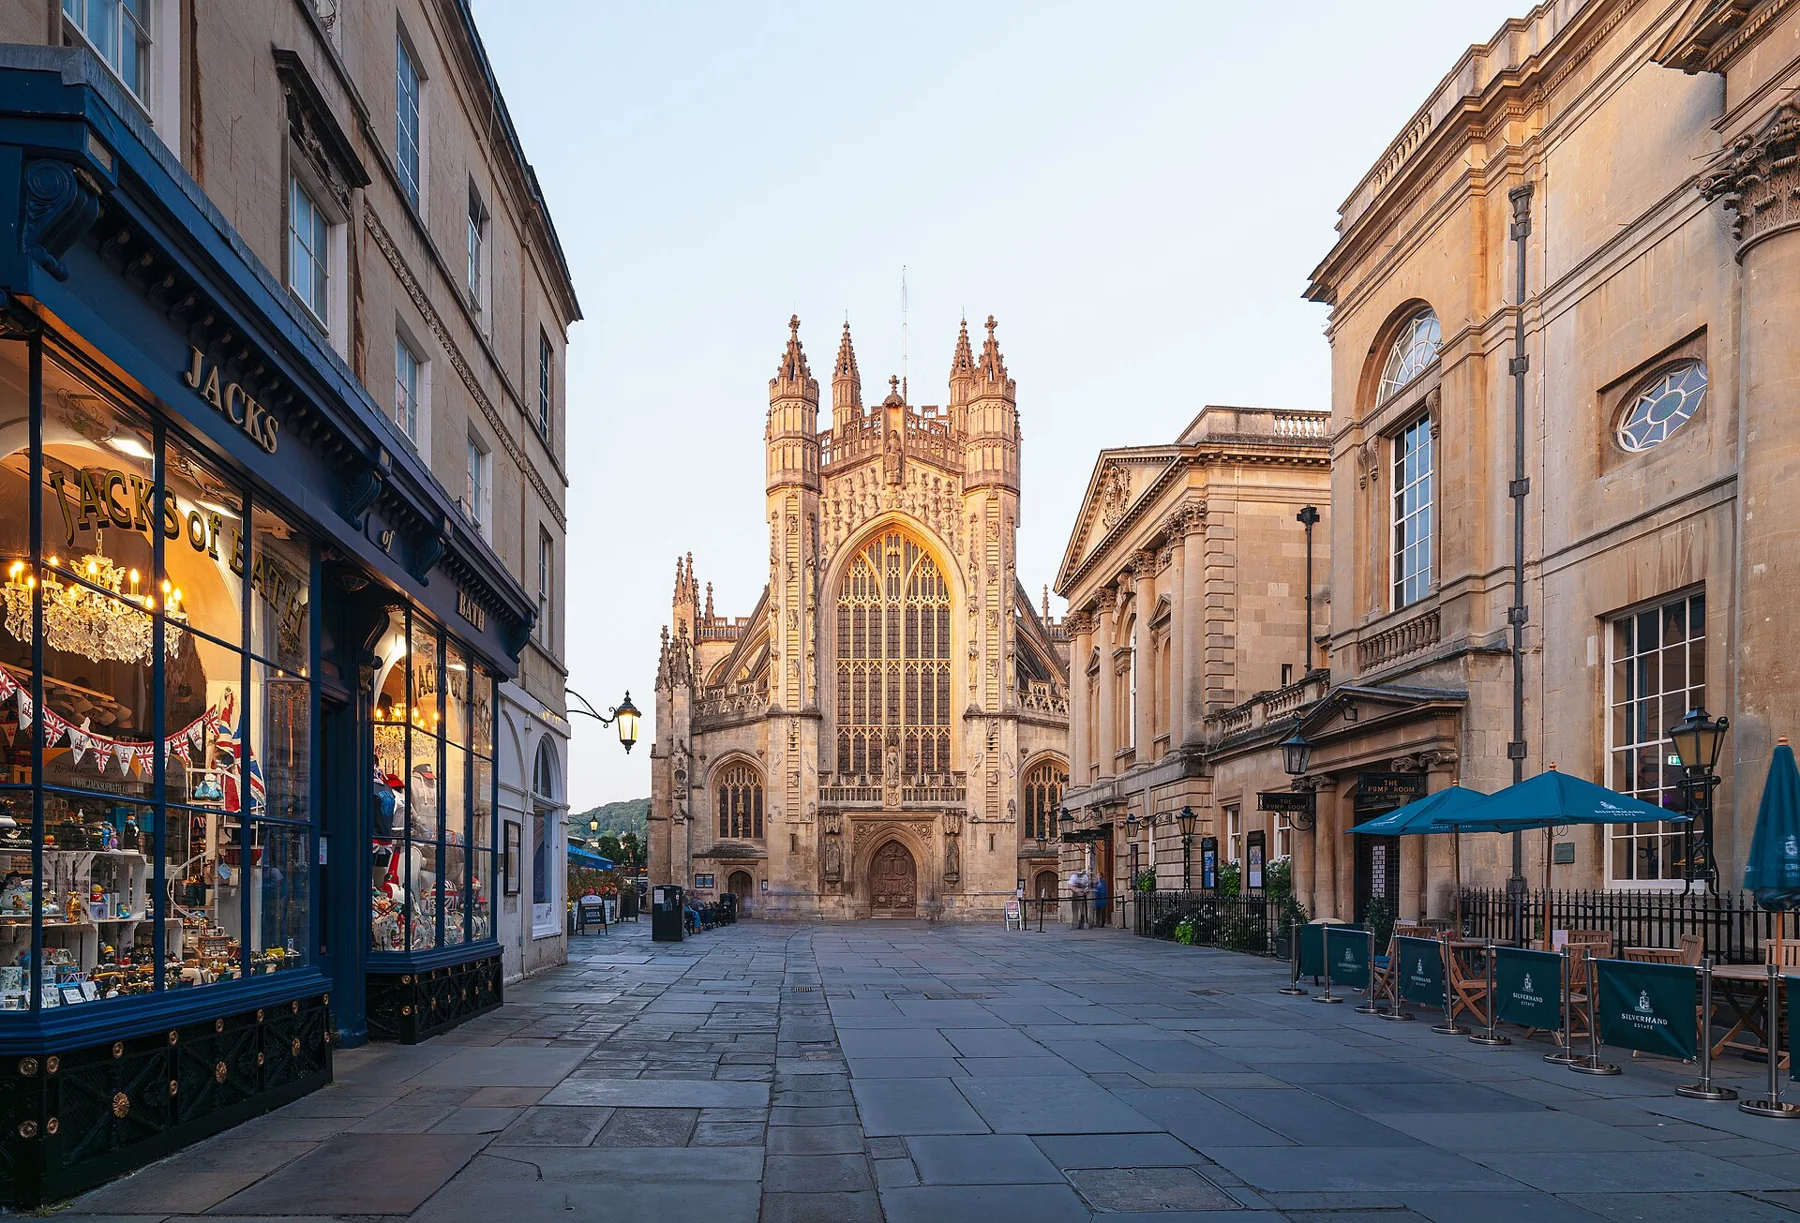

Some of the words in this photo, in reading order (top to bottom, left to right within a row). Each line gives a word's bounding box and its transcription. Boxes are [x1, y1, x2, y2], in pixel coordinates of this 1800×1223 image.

[184, 345, 279, 454] JACKS
[382, 529, 396, 553] of
[457, 590, 485, 633] BATH
[49, 468, 180, 547] JACKS
[187, 510, 222, 561] of
[229, 526, 306, 640] BATH
[1512, 992, 1544, 1003] SILVERHAND
[1621, 1013, 1668, 1026] SILVERHAND
